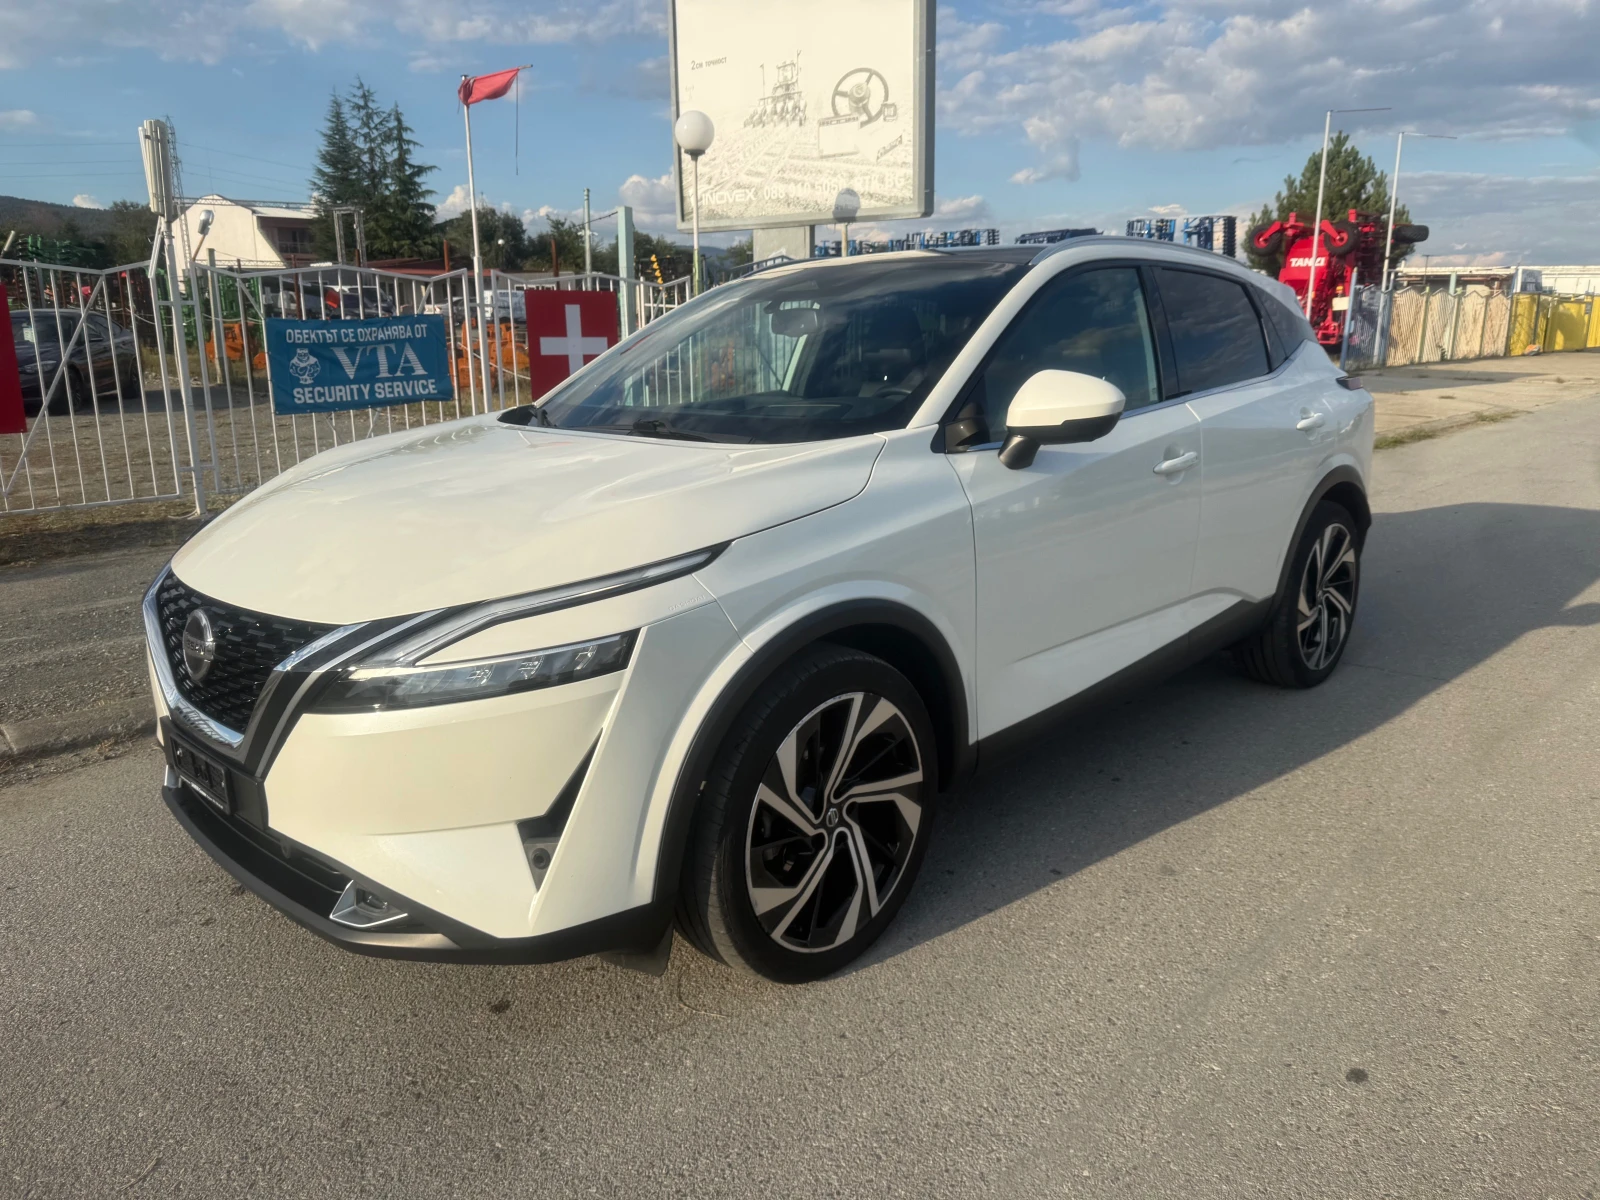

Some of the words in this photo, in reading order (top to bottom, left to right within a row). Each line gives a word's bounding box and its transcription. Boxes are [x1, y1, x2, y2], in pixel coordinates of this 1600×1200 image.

[286, 329, 338, 343] ОБЕКТЪТ
[340, 328, 356, 343] СЕ
[357, 325, 413, 342] ОХРАНЯВА
[414, 324, 428, 338] ОТ
[330, 341, 428, 380] VTA
[293, 383, 370, 404] SECURITY
[375, 379, 438, 398] SERVICE
